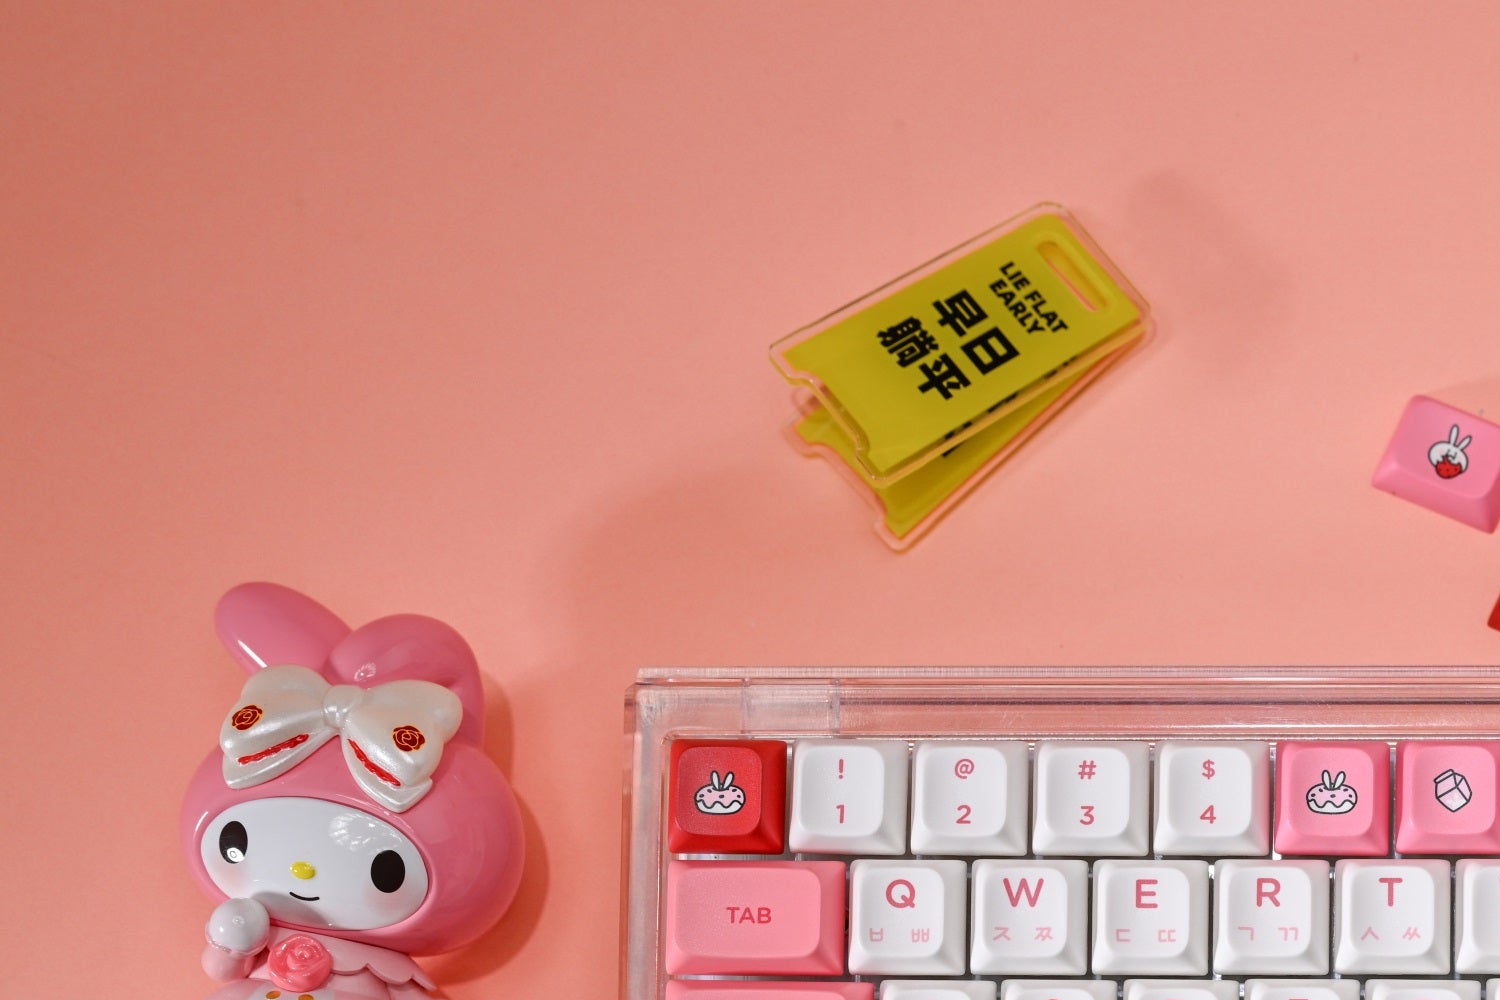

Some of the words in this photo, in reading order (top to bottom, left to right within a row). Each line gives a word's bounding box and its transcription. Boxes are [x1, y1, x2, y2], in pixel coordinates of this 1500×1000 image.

[988, 278, 1045, 334] EARLY
[1000, 262, 1031, 291] LIE
[1024, 290, 1068, 333] FLAT
[932, 289, 1020, 375] 早日
[876, 316, 971, 400] 躺平
[835, 804, 845, 824] 1
[955, 804, 972, 825] 2
[1079, 805, 1095, 826] 3
[1199, 804, 1217, 825] 4
[885, 878, 916, 909] Q
[1002, 877, 1045, 908] W
[1135, 878, 1159, 909] E
[1256, 877, 1281, 908] R
[1378, 877, 1404, 907] T
[725, 906, 772, 925] TAB
